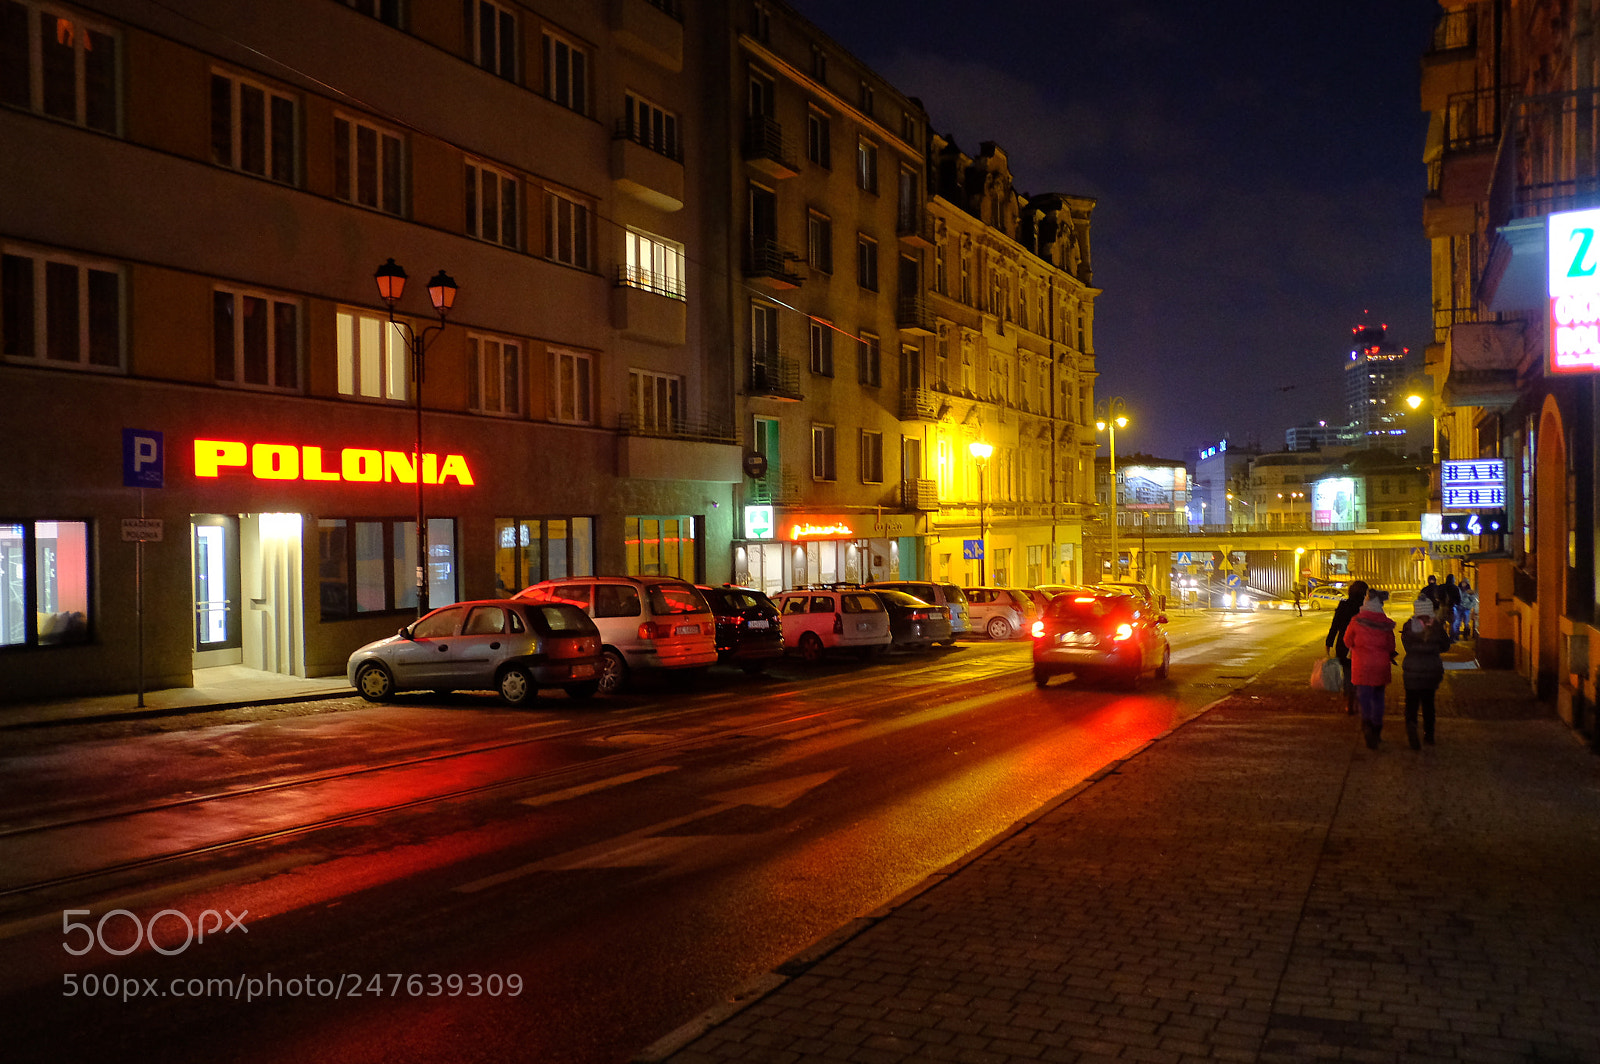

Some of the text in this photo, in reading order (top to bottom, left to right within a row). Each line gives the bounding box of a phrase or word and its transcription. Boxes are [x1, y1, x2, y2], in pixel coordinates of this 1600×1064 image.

[134, 436, 157, 472] P
[193, 439, 475, 486] POLONIA
[1448, 464, 1500, 480] BAR
[1434, 544, 1470, 553] KSERO
